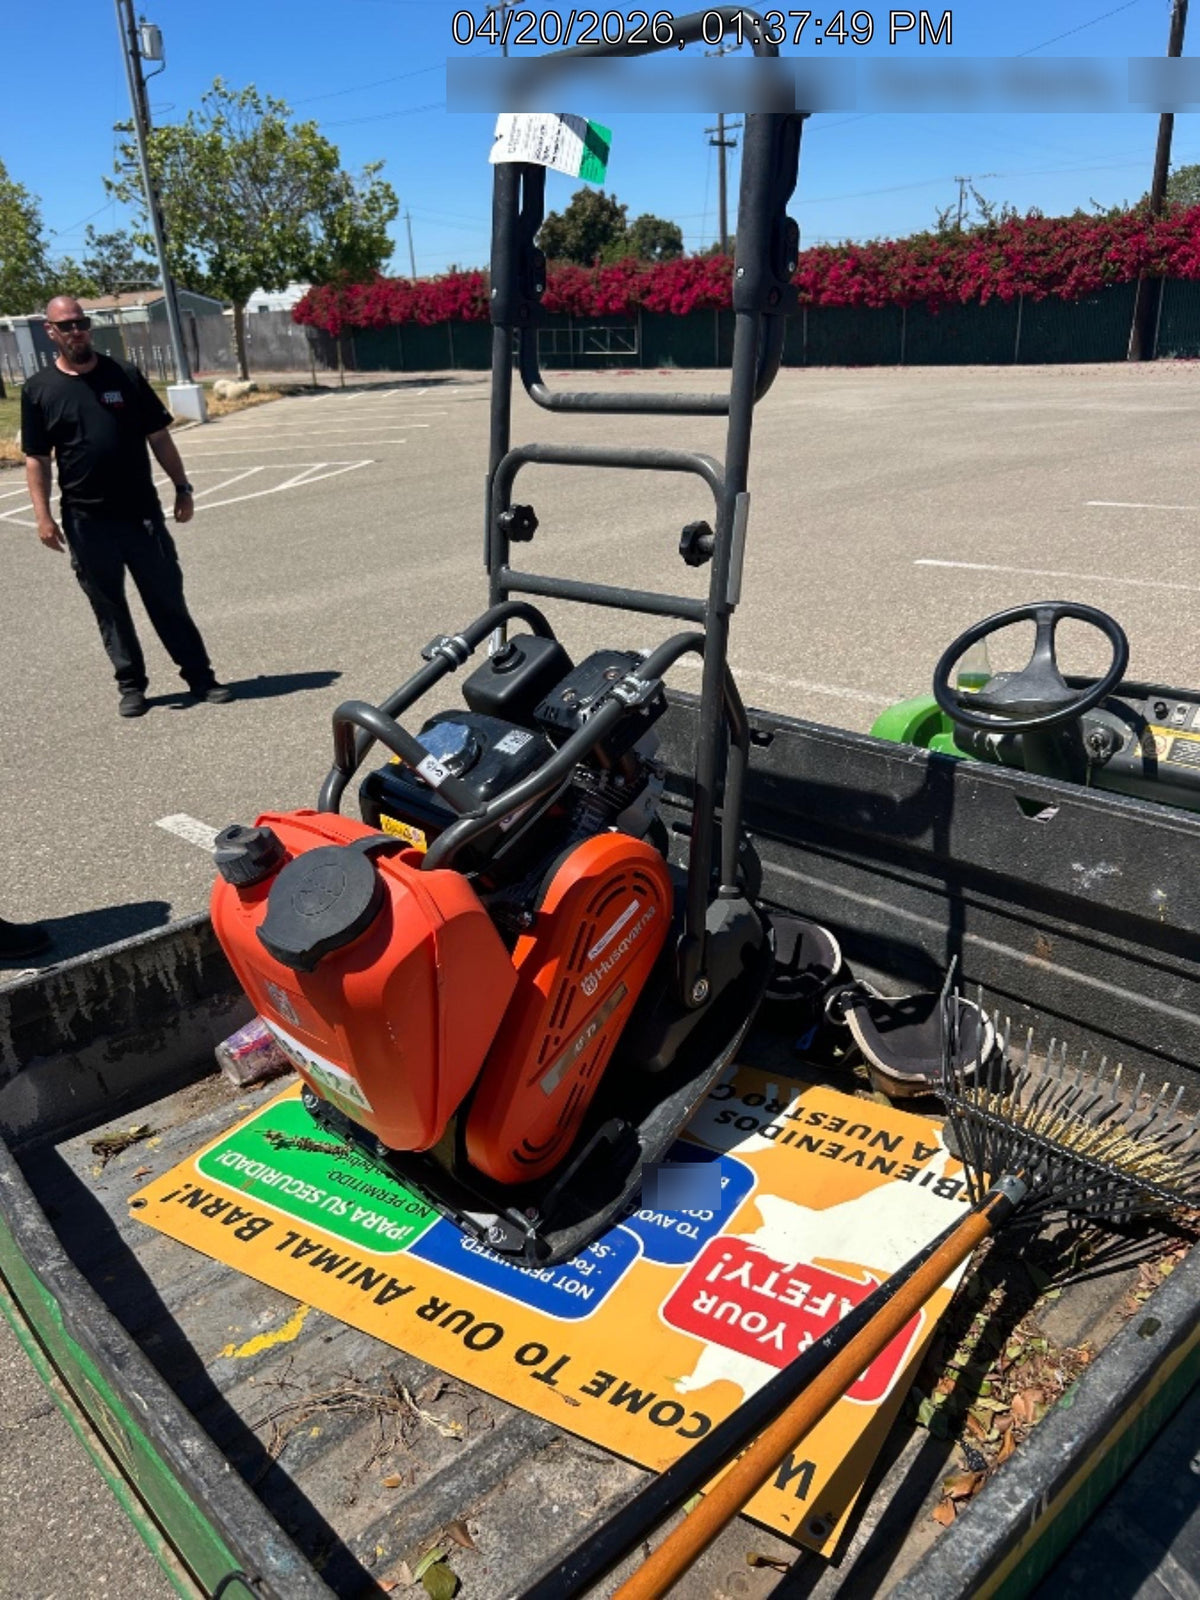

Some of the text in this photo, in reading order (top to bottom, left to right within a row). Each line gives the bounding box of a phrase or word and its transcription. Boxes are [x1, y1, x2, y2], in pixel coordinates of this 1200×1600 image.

[594, 905, 656, 980] Husqvarna
[742, 1093, 943, 1159] A NUESTRO
[214, 1149, 416, 1241] ¡PARA SU SEGURIDAD!
[328, 1169, 404, 1210] PERMITIDO:
[405, 1203, 433, 1219] NO
[675, 1220, 700, 1240] TO
[552, 1275, 595, 1301] NOT
[704, 1252, 855, 1320] AFETY!
[160, 1183, 816, 1500] WCOME TO OUR ANIMAL BARN!
[691, 1290, 787, 1350] YOUR
